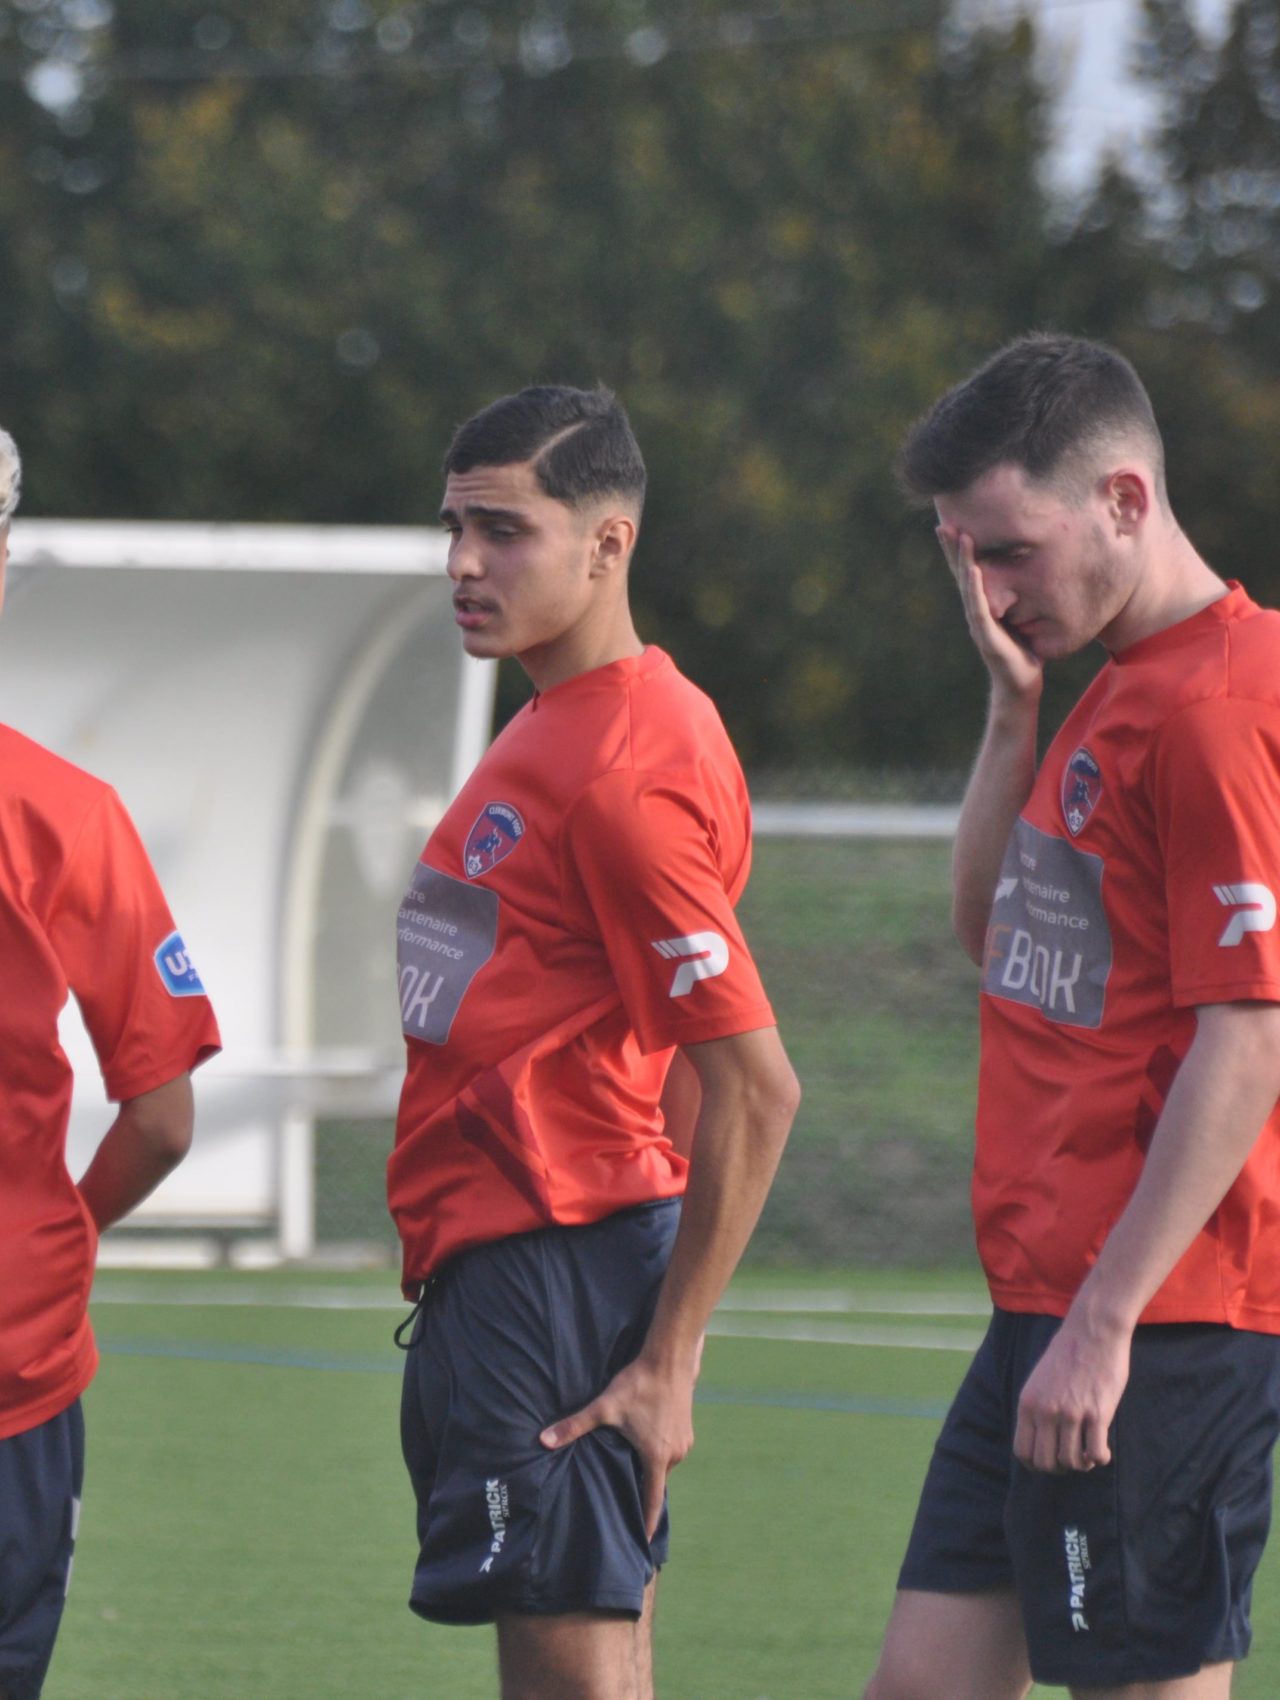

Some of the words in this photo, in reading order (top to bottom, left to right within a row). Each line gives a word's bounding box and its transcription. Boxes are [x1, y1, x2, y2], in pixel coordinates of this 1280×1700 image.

[405, 887, 426, 904] tre
[398, 907, 459, 937] artenaire
[398, 927, 464, 960] rformance
[486, 1479, 506, 1553] PATRICK
[1065, 1529, 1085, 1609] PATRICK
